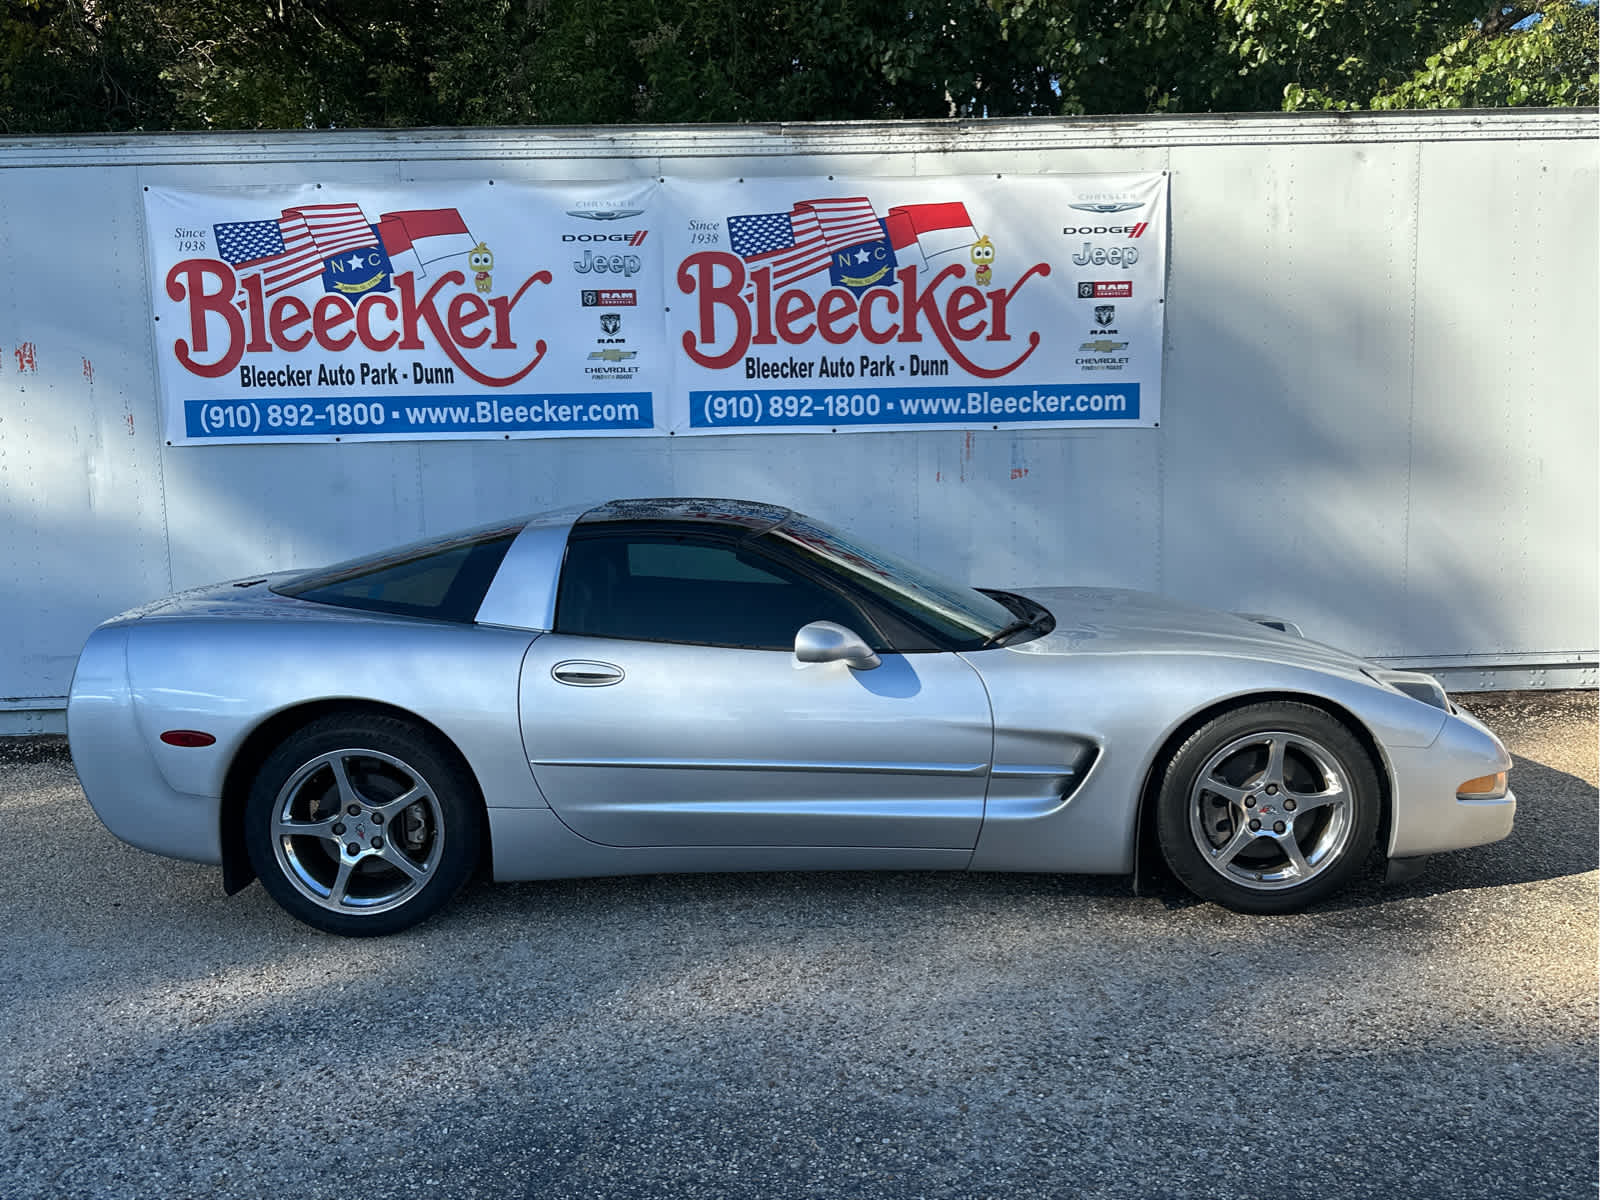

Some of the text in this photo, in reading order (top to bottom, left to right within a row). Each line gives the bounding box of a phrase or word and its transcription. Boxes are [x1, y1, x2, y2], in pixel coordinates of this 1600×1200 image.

[575, 200, 635, 208] CHRYSLER
[174, 227, 206, 239] Since
[688, 219, 720, 231] Since
[1063, 226, 1136, 235] DODGE
[177, 241, 206, 252] 1938
[562, 234, 634, 242] DODGE
[690, 233, 719, 244] 1938
[331, 252, 381, 274] N C
[573, 250, 641, 277] Jeep
[839, 246, 887, 268] N C
[1072, 242, 1139, 269] Jeep
[166, 258, 553, 388] Bleecker
[677, 250, 1052, 379] Bleecker
[584, 366, 640, 374] CHEVROLET
[745, 356, 814, 379] Bleecker
[818, 356, 855, 378] Auto
[860, 354, 895, 377] Park
[909, 354, 949, 376] Dunn
[1075, 357, 1129, 365] CHEVROLET
[240, 363, 313, 388] Bleecker
[317, 362, 355, 387] Auto
[360, 361, 399, 386] Park
[413, 362, 455, 385] Dunn
[200, 400, 640, 433] (910) 892-1800 www.Bleecker.com
[704, 391, 1127, 423] (910) 892-1800 www.Bleecker.com
